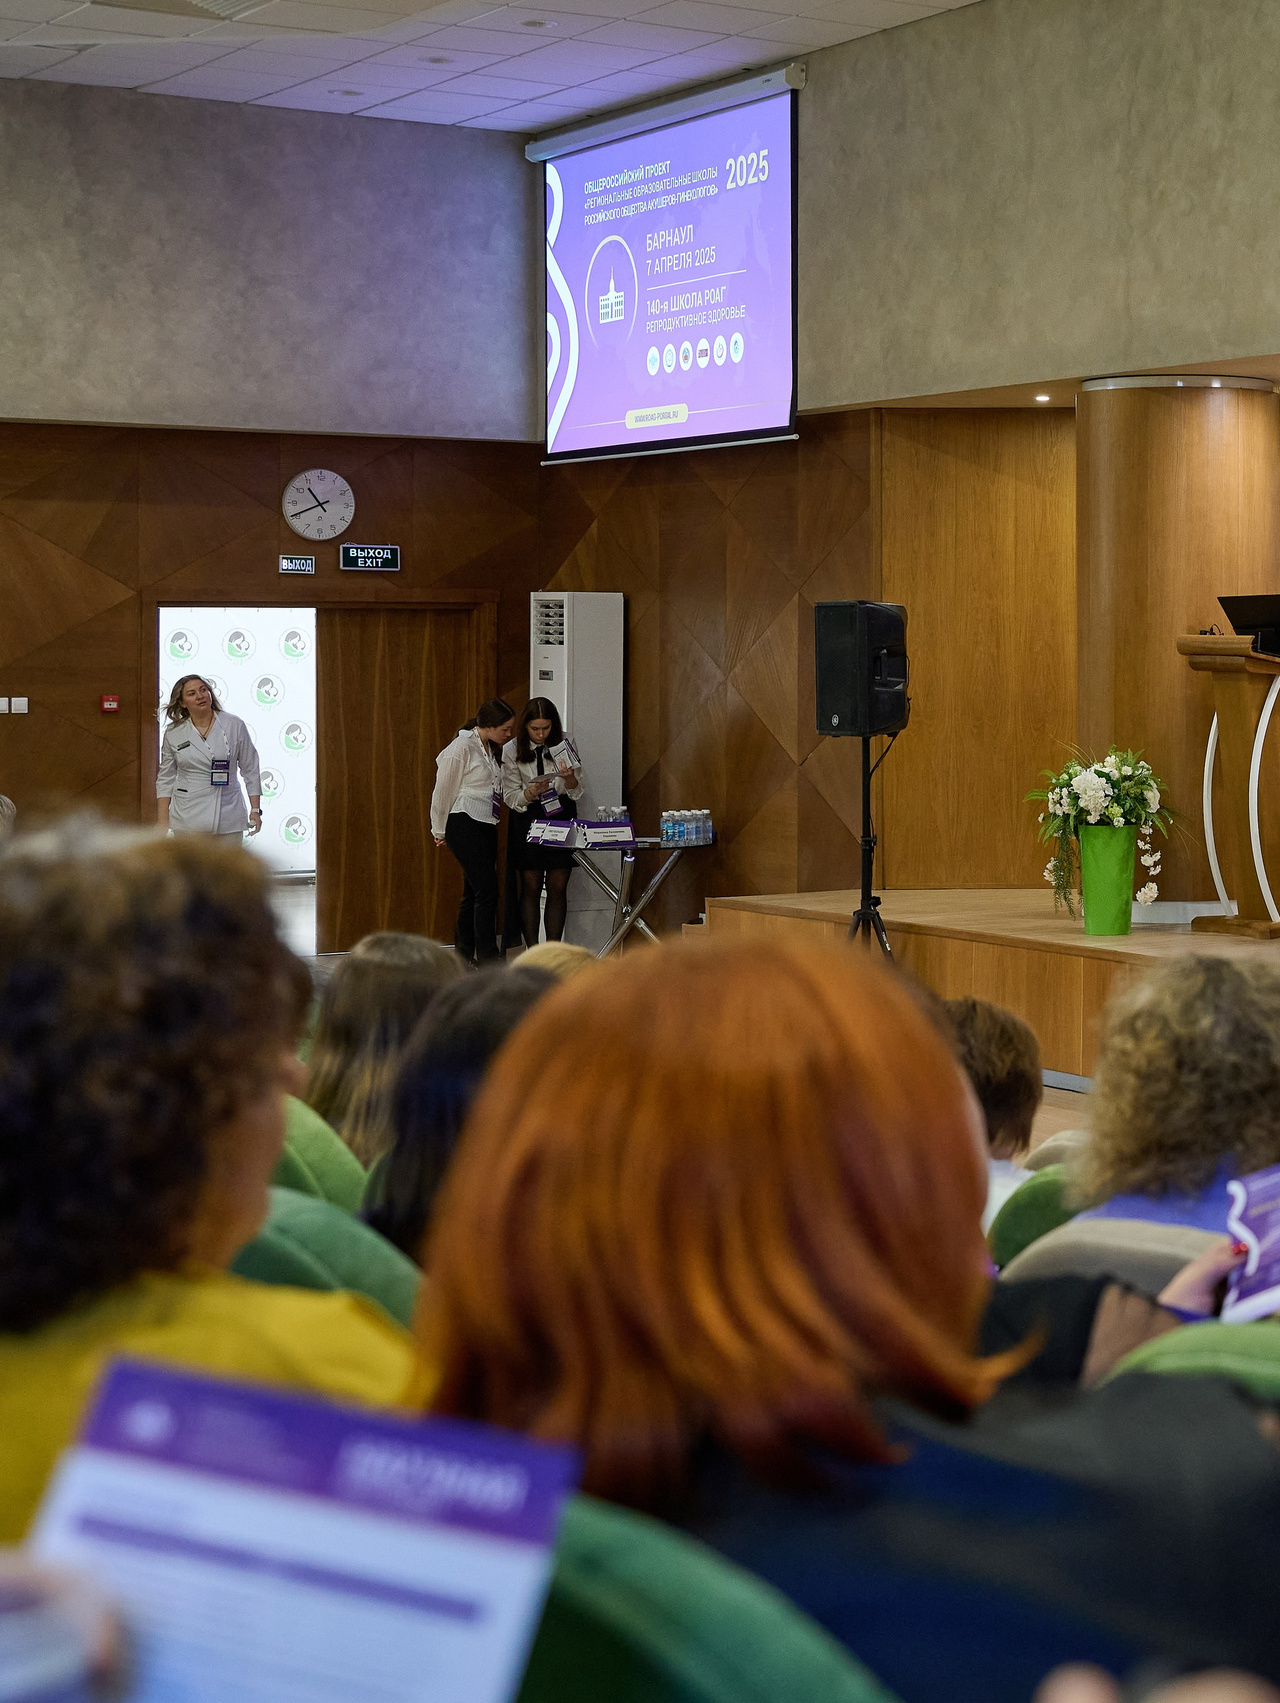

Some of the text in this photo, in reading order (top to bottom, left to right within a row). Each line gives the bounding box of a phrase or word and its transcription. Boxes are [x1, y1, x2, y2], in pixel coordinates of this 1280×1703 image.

[584, 161, 671, 194] ОБЩЕРОССИЙСКИЙ ПРОЕКТ
[725, 149, 770, 190] 2025
[584, 166, 718, 210] «РЕГИОНАЛЬНЫЕ ОБРАЗОВАТЕЛЬНЫЕ ШКОЛЫ
[584, 207, 620, 226] РОССИЙСКОГО
[620, 201, 648, 218] ОБЩЕСТВА
[646, 224, 694, 252] БАРНАУЛ
[646, 246, 716, 276] 7 АПРЕЛЯ 2025
[646, 286, 727, 316] 140-я ШКОЛА РОАГ
[646, 305, 746, 333] РЕПРОДУКТИВНОЕ ЗДОРОВЬЕ
[282, 559, 312, 571] ВЫХОД
[350, 548, 391, 559] ВЫХОД
[358, 558, 383, 567] EXIT
